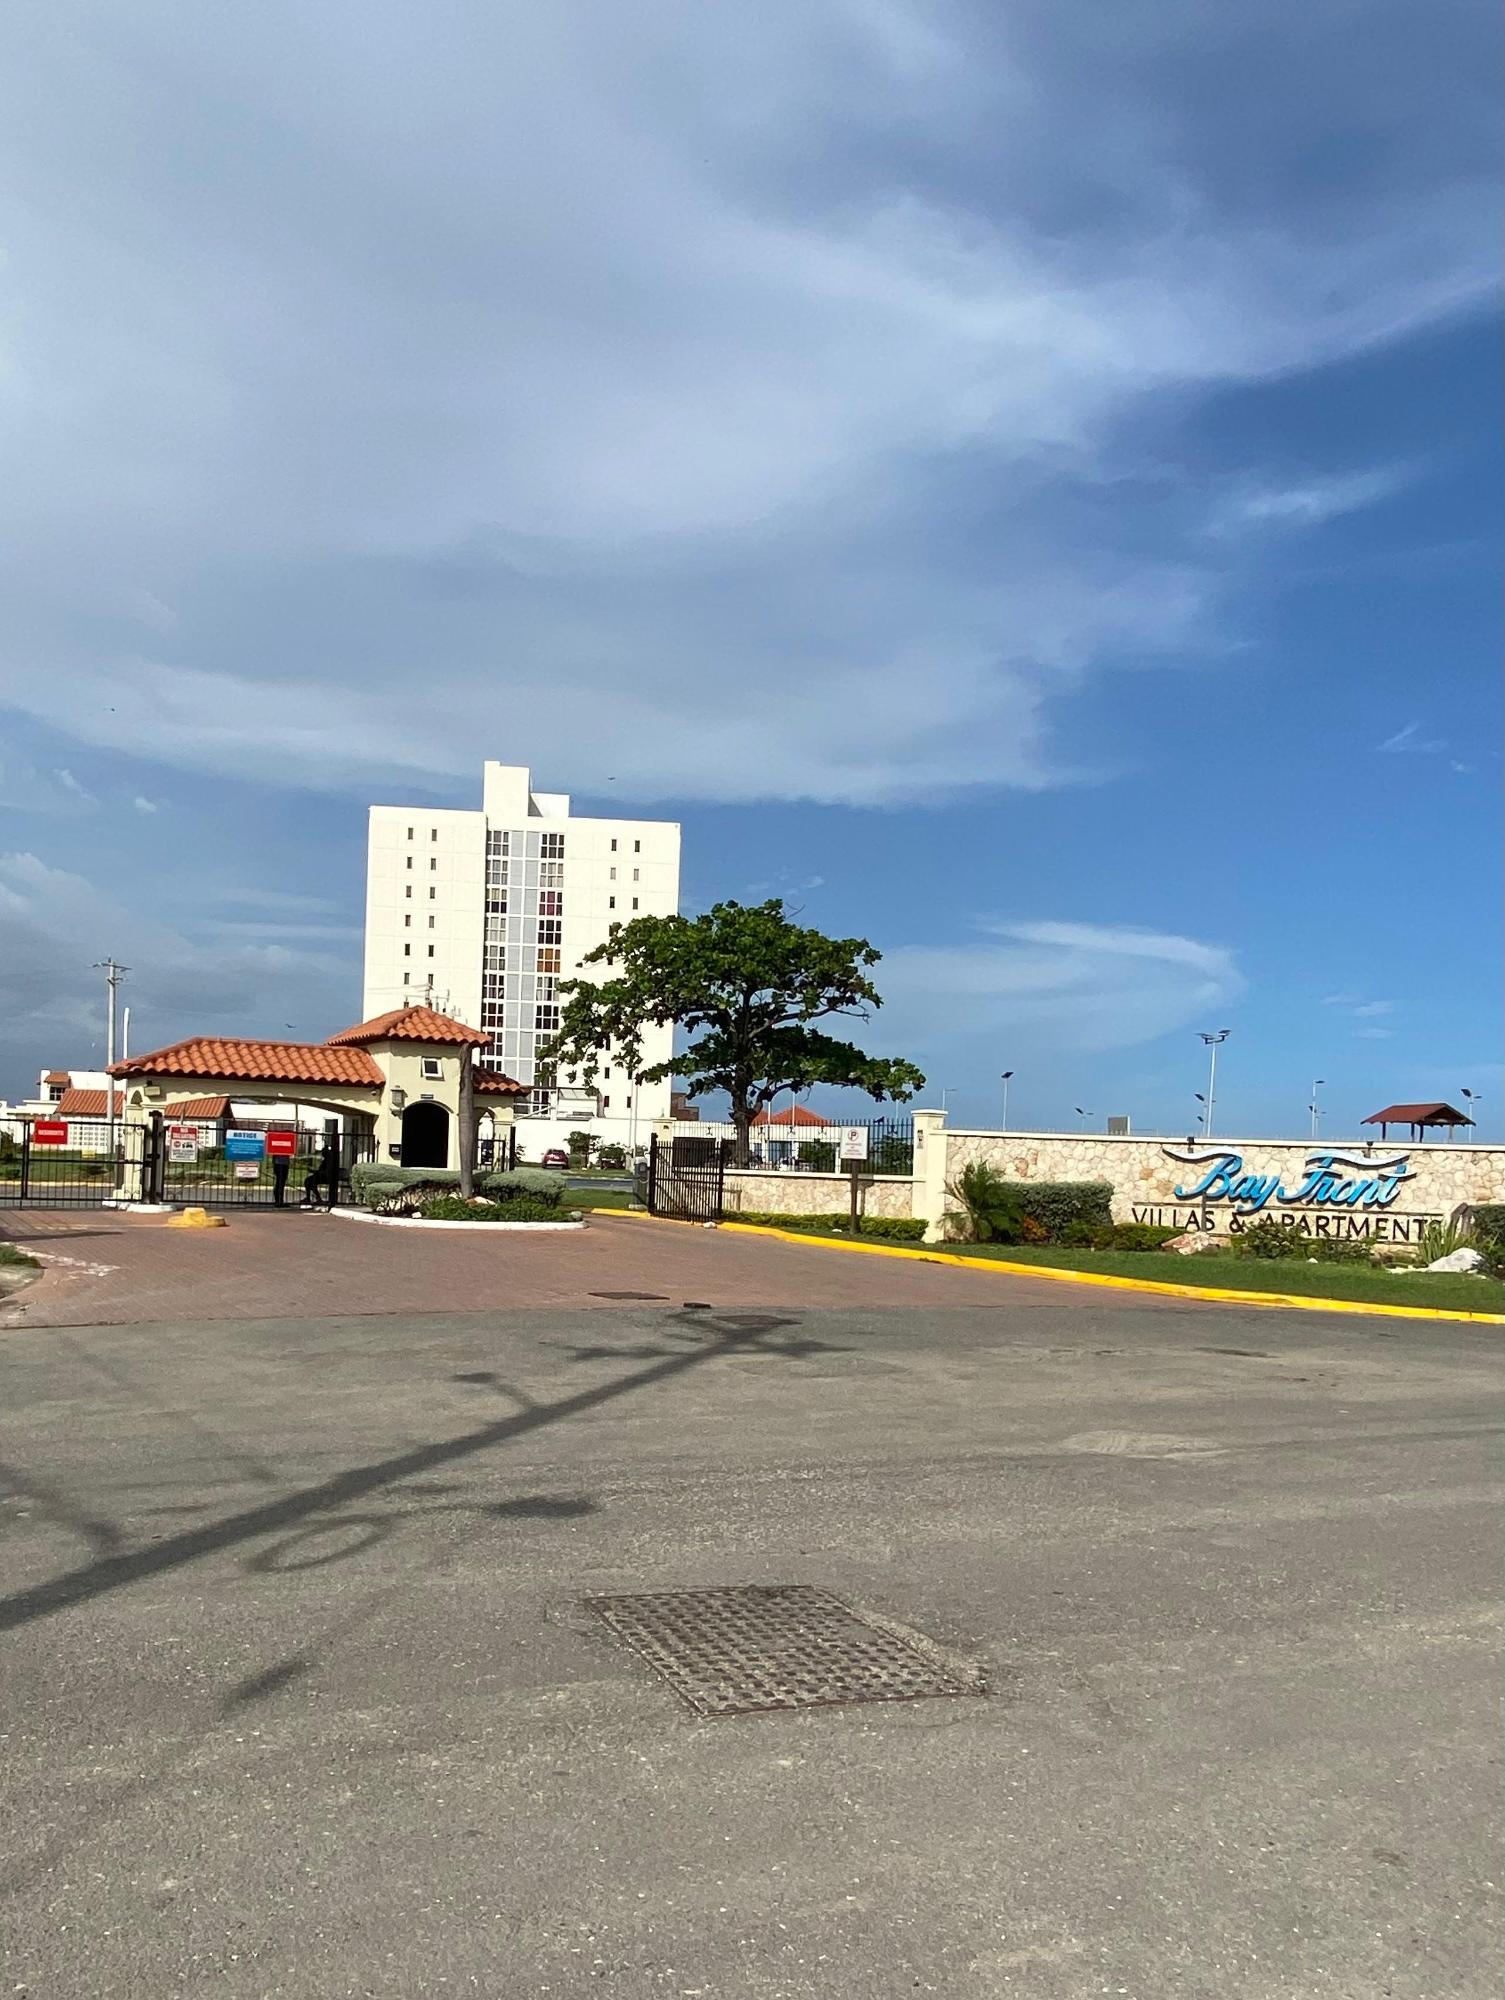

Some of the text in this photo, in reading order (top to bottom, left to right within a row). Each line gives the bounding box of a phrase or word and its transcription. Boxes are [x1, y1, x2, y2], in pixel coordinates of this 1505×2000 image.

[1161, 1145, 1417, 1216] Bay Front
[1131, 1207, 1216, 1232] VILLAS
[1229, 1211, 1247, 1234] &
